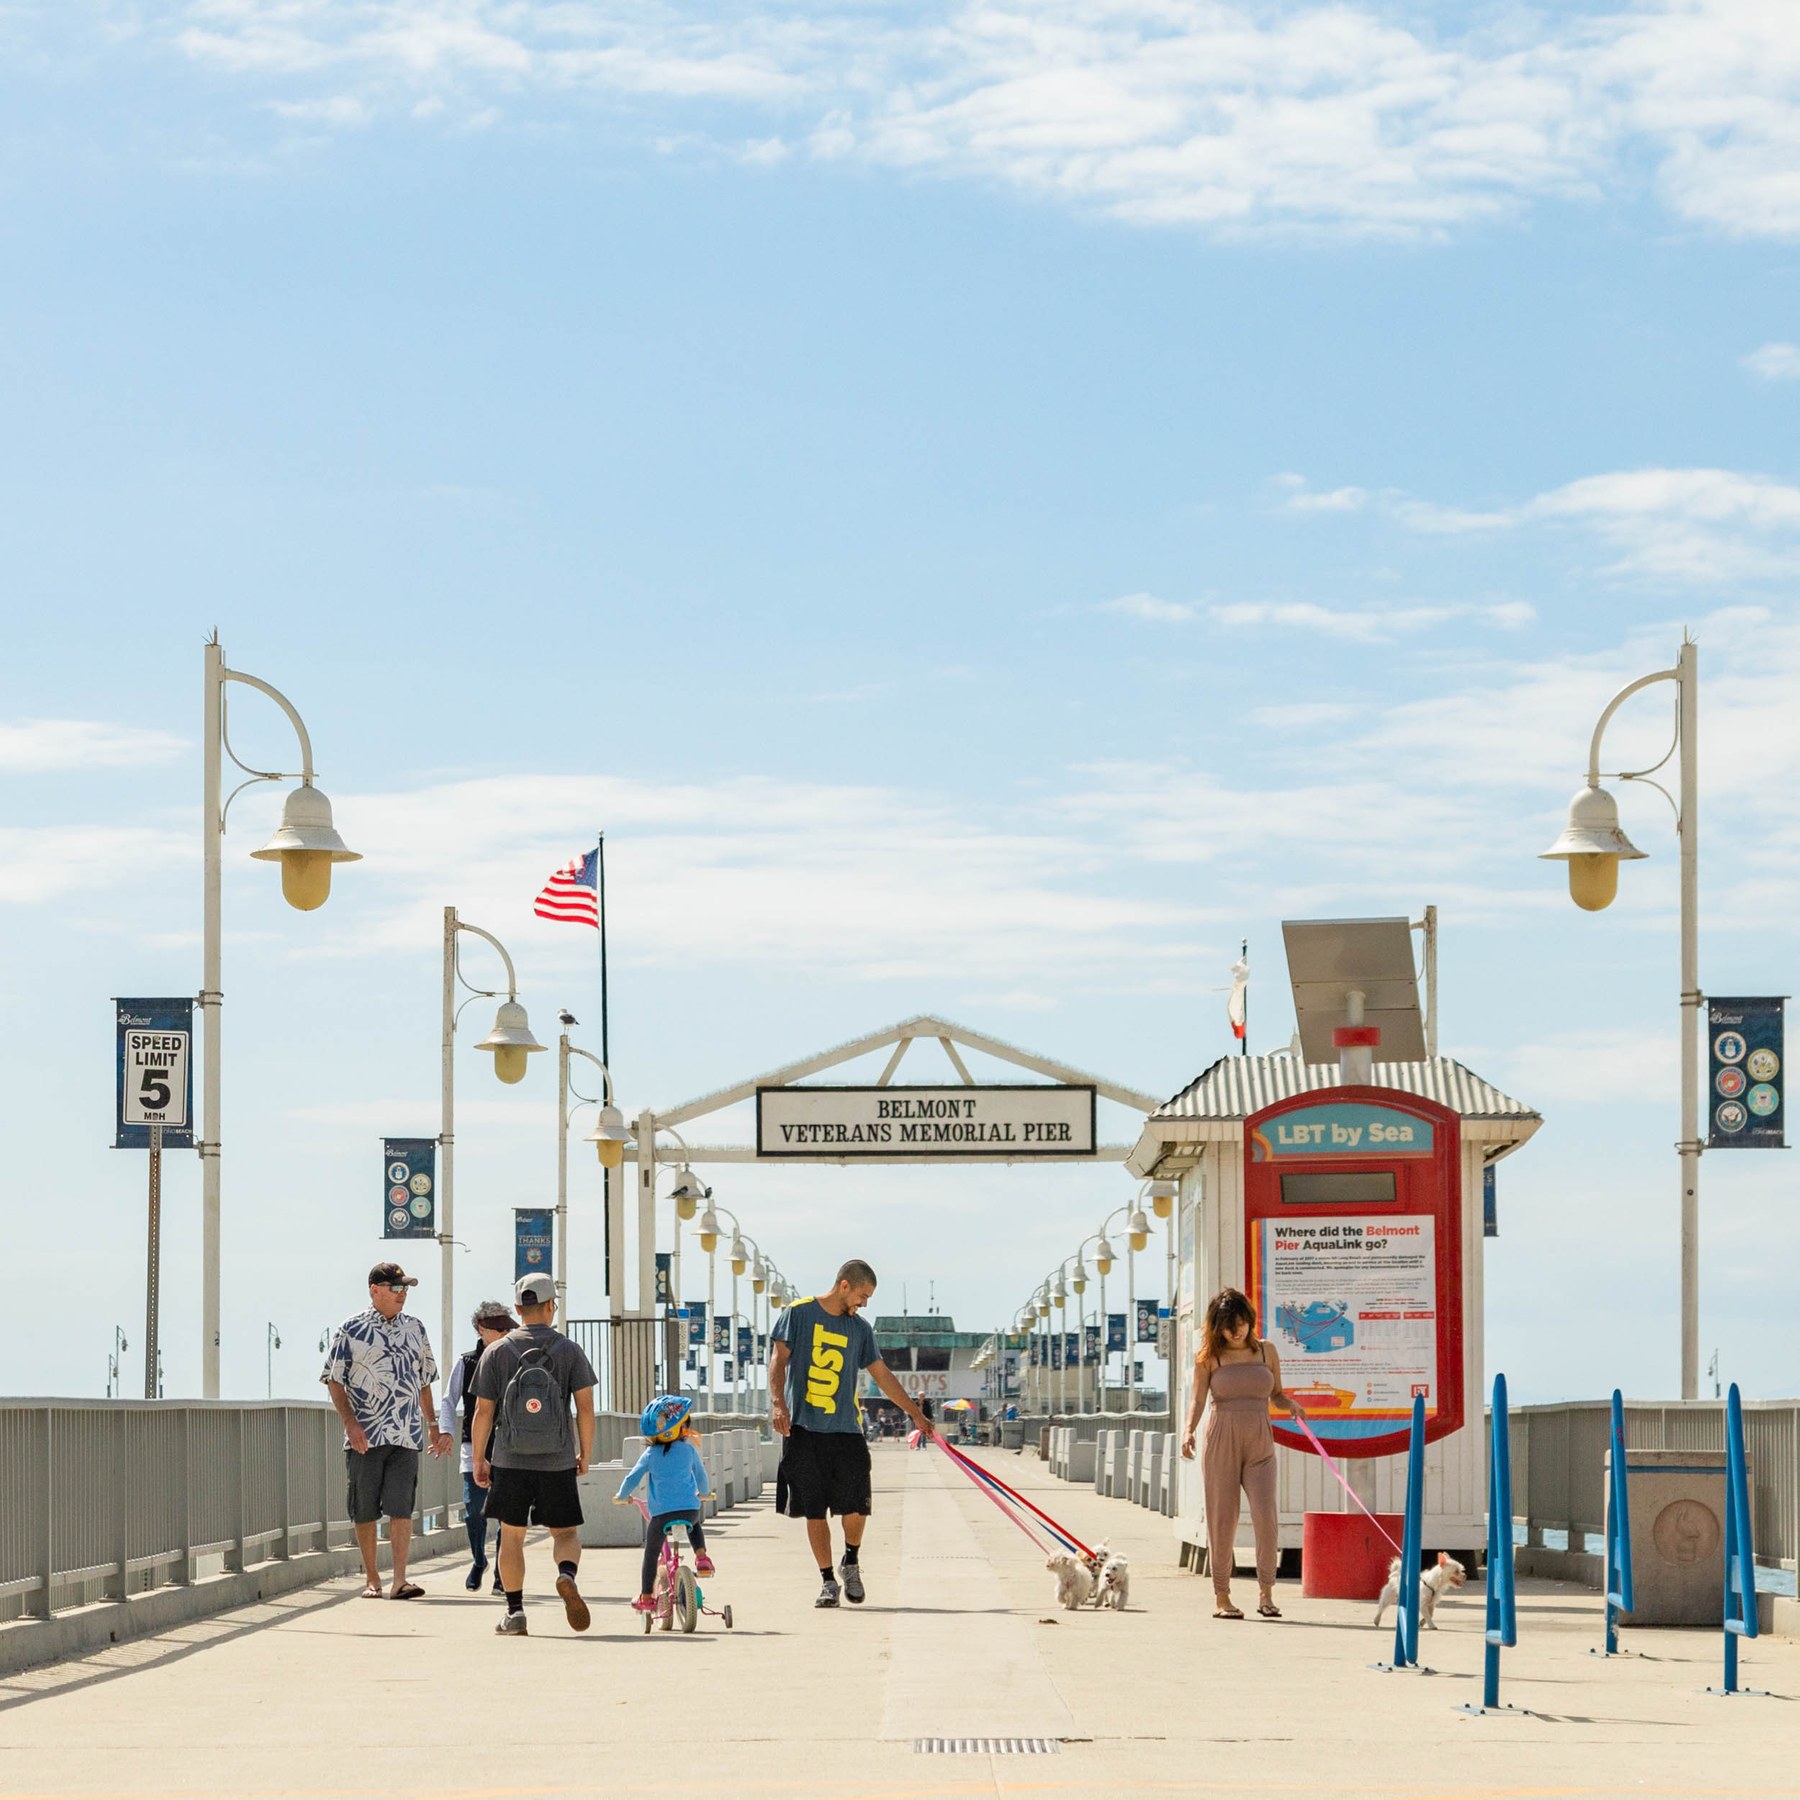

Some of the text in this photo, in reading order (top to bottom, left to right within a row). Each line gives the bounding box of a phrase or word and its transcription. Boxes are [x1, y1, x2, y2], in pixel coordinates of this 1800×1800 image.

[131, 1035, 182, 1050] SPEED
[135, 1052, 178, 1067] LIMIT
[138, 1069, 171, 1110] 5
[877, 1100, 976, 1118] BELMONT
[780, 1122, 1072, 1143] VETERANS MEMORIAL PIER
[1278, 1122, 1414, 1147] LBT by Sea
[1275, 1225, 1420, 1237] Where did the Belmont
[1275, 1239, 1388, 1252] Pier AquaLink go?
[805, 1323, 849, 1414] JUST
